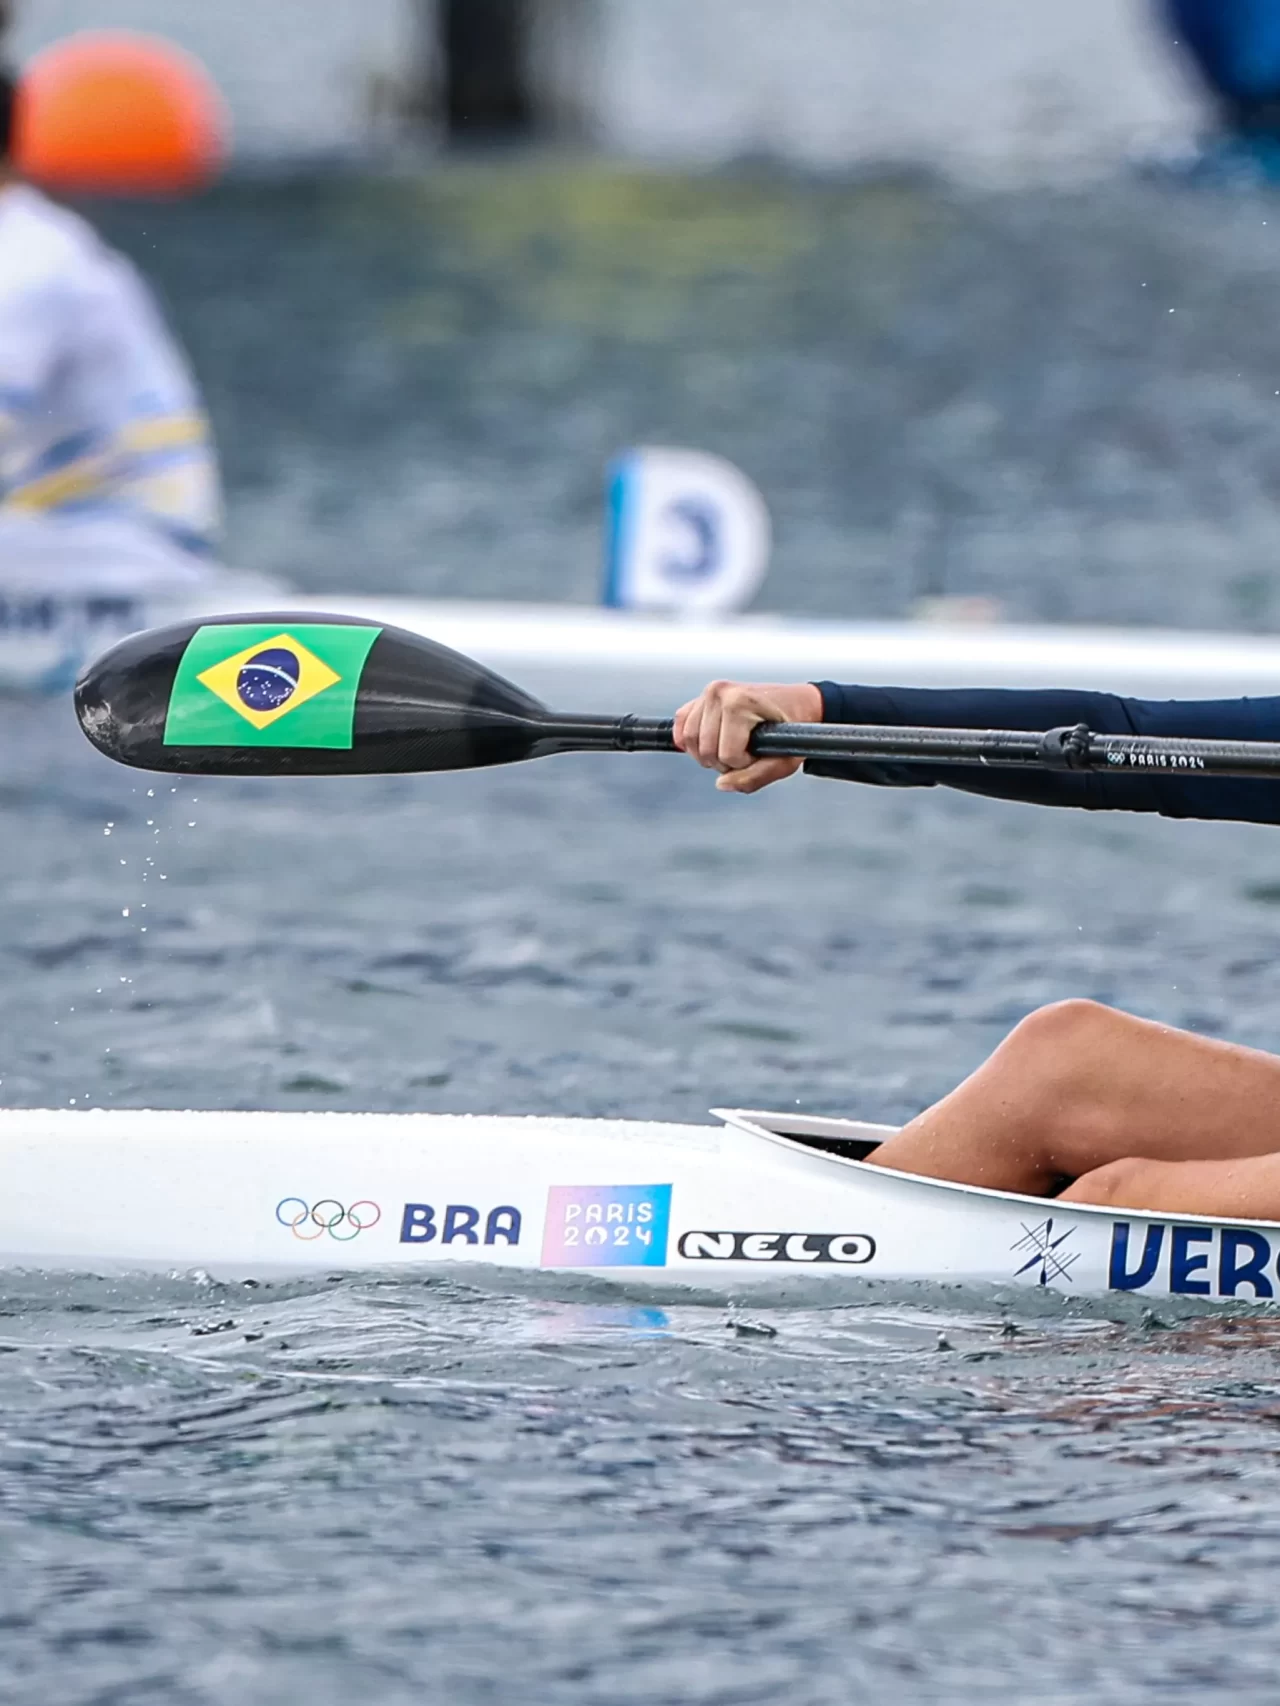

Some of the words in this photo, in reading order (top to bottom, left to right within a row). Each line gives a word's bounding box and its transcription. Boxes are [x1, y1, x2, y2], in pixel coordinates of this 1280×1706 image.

[1130, 753, 1167, 767] PARIS
[1170, 755, 1204, 769] 2024
[399, 1203, 522, 1246] BRA
[564, 1202, 653, 1224] PARIS
[563, 1224, 652, 1248] 2024
[682, 1232, 873, 1262] NELO
